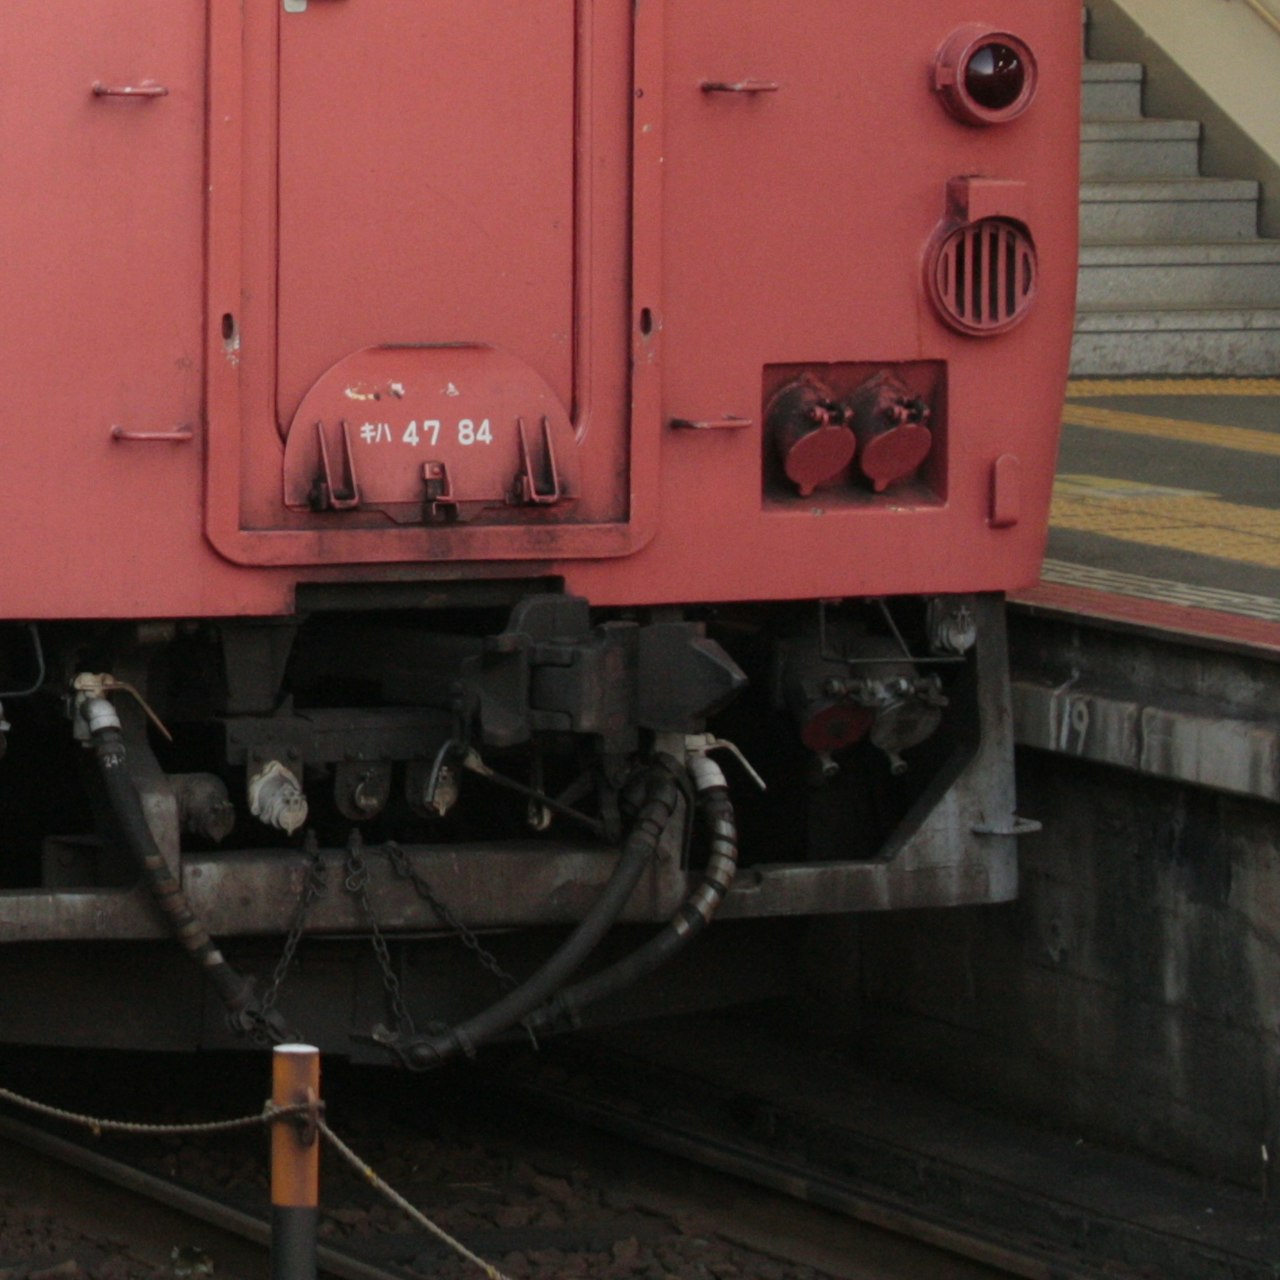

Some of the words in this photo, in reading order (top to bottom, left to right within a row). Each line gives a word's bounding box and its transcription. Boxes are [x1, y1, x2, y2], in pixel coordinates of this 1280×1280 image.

[360, 422, 392, 445] キハ
[402, 419, 441, 446] 47
[457, 418, 493, 445] 84
